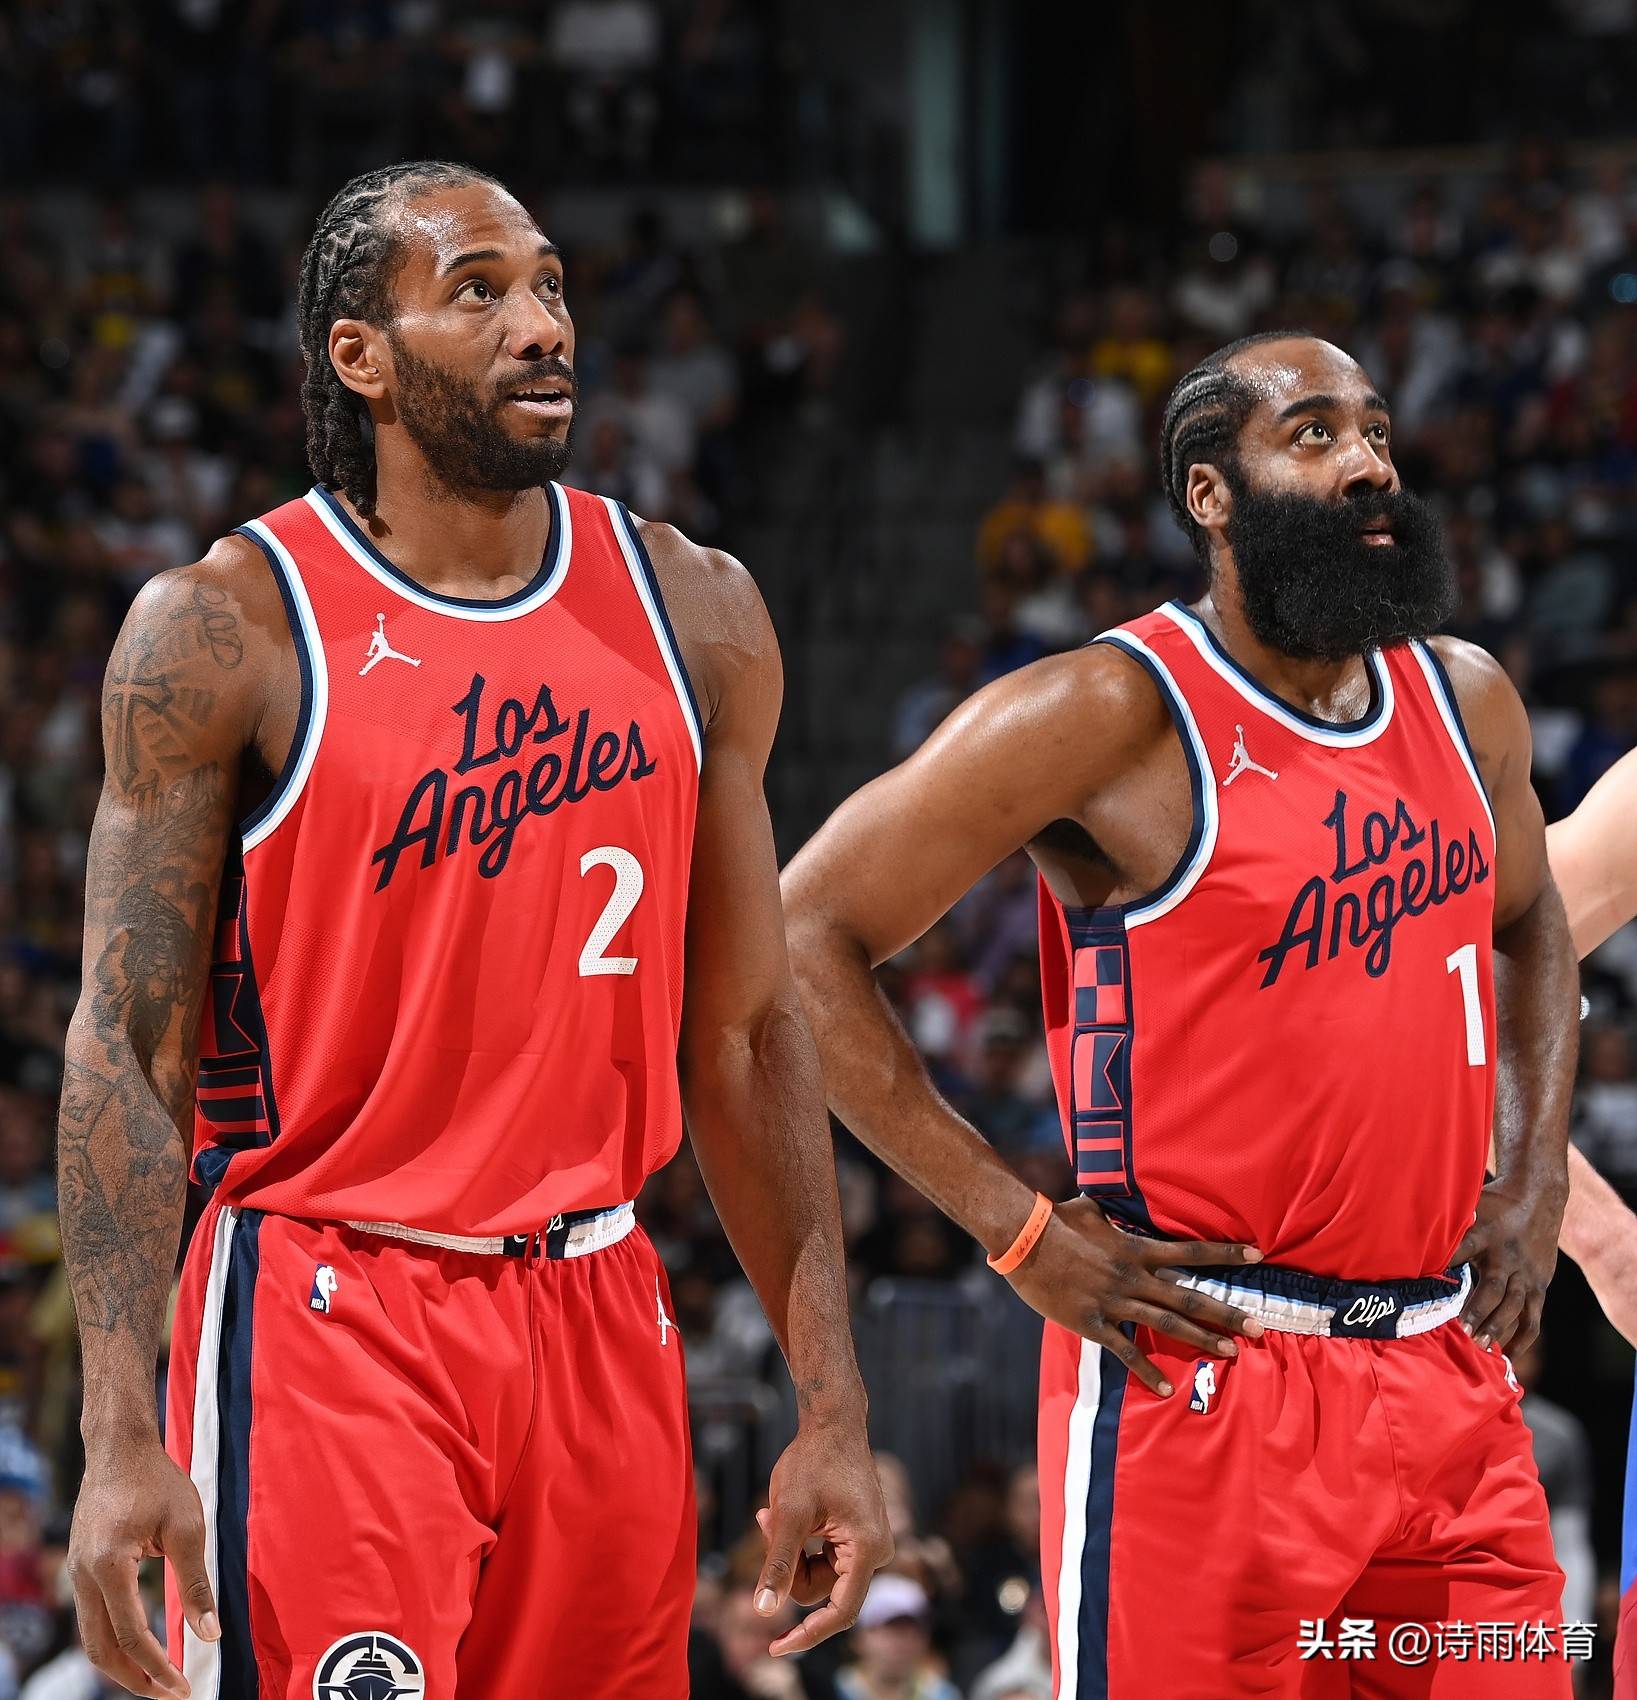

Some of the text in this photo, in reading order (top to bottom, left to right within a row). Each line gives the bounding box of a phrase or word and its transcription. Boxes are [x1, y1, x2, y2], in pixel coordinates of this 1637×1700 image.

[451, 672, 570, 776] Los
[371, 708, 657, 895] Angeles
[1322, 788, 1425, 884] Los
[578, 845, 644, 977] 2
[1257, 818, 1489, 990] Angeles
[1445, 943, 1487, 1066] 1
[1342, 1294, 1397, 1328] Clips
